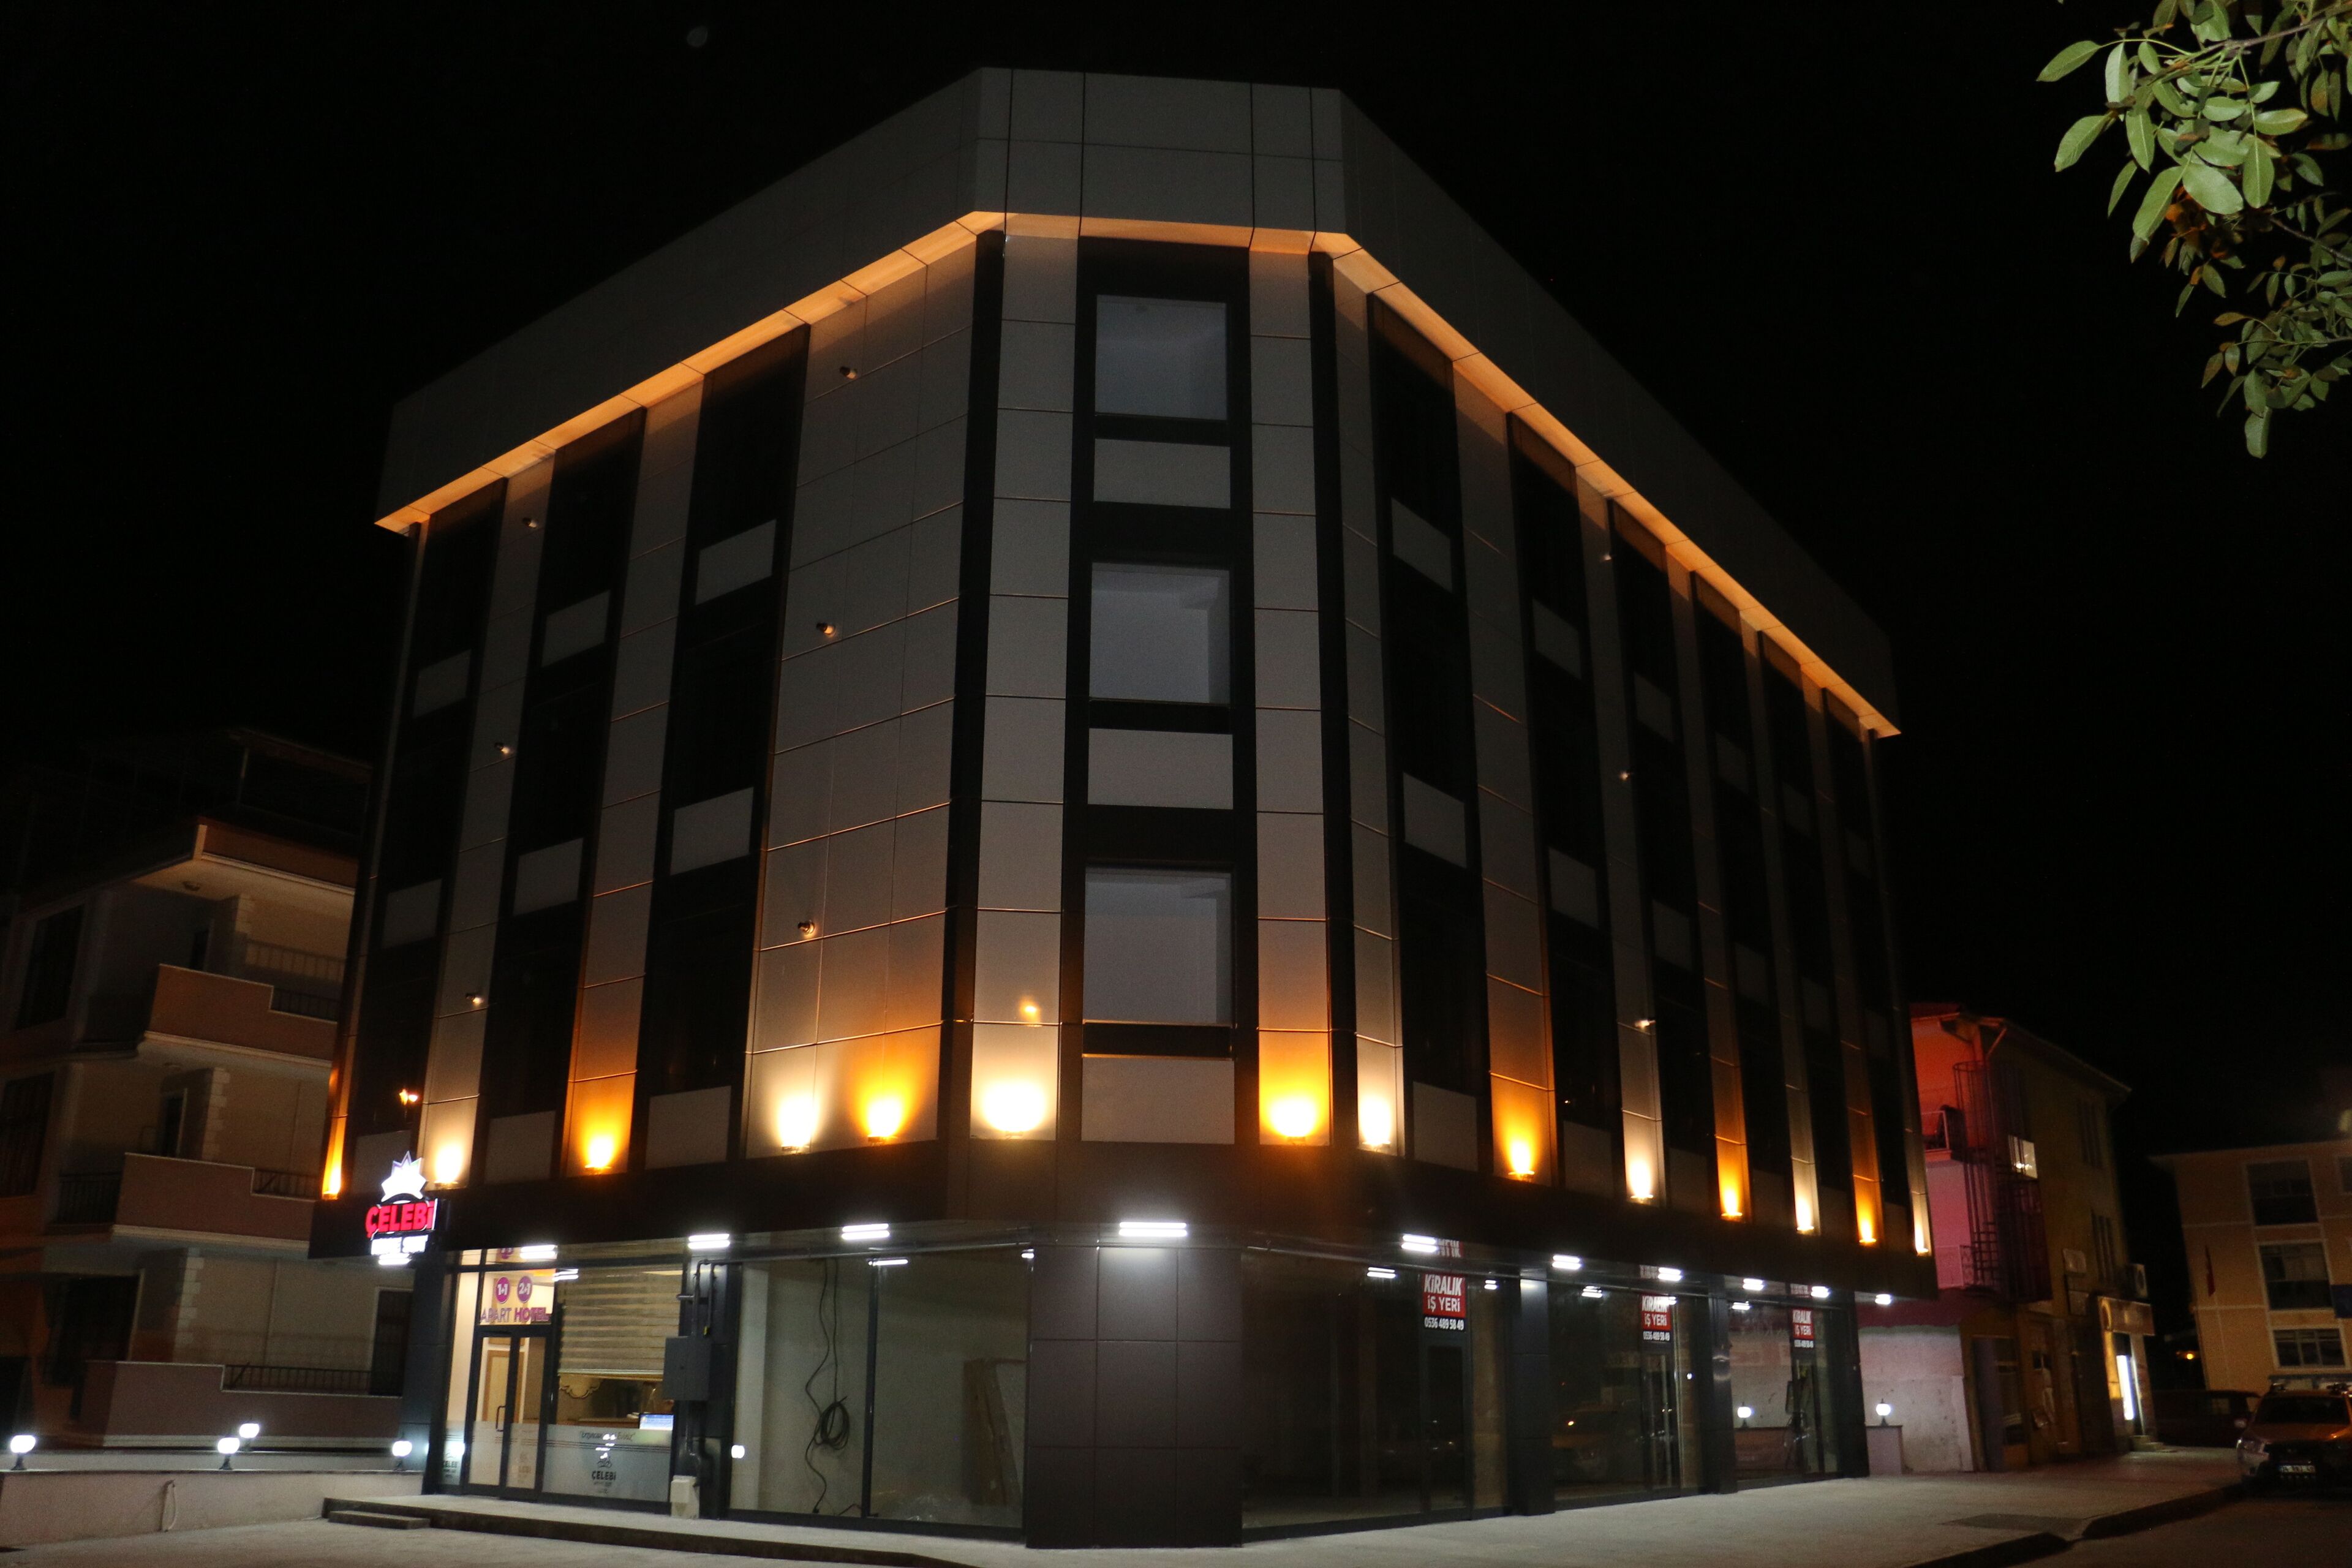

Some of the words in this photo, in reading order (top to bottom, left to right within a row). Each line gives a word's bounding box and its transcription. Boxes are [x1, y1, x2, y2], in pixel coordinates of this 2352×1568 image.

[366, 1200, 435, 1238] ÇELEBİ
[1423, 1274, 1463, 1296] KİRALIK
[1427, 1295, 1436, 1313] İŞ
[1439, 1297, 1460, 1313] YERİ
[480, 1307, 511, 1322] APART
[514, 1306, 549, 1322] HOTEL
[1424, 1316, 1438, 1329] 0536
